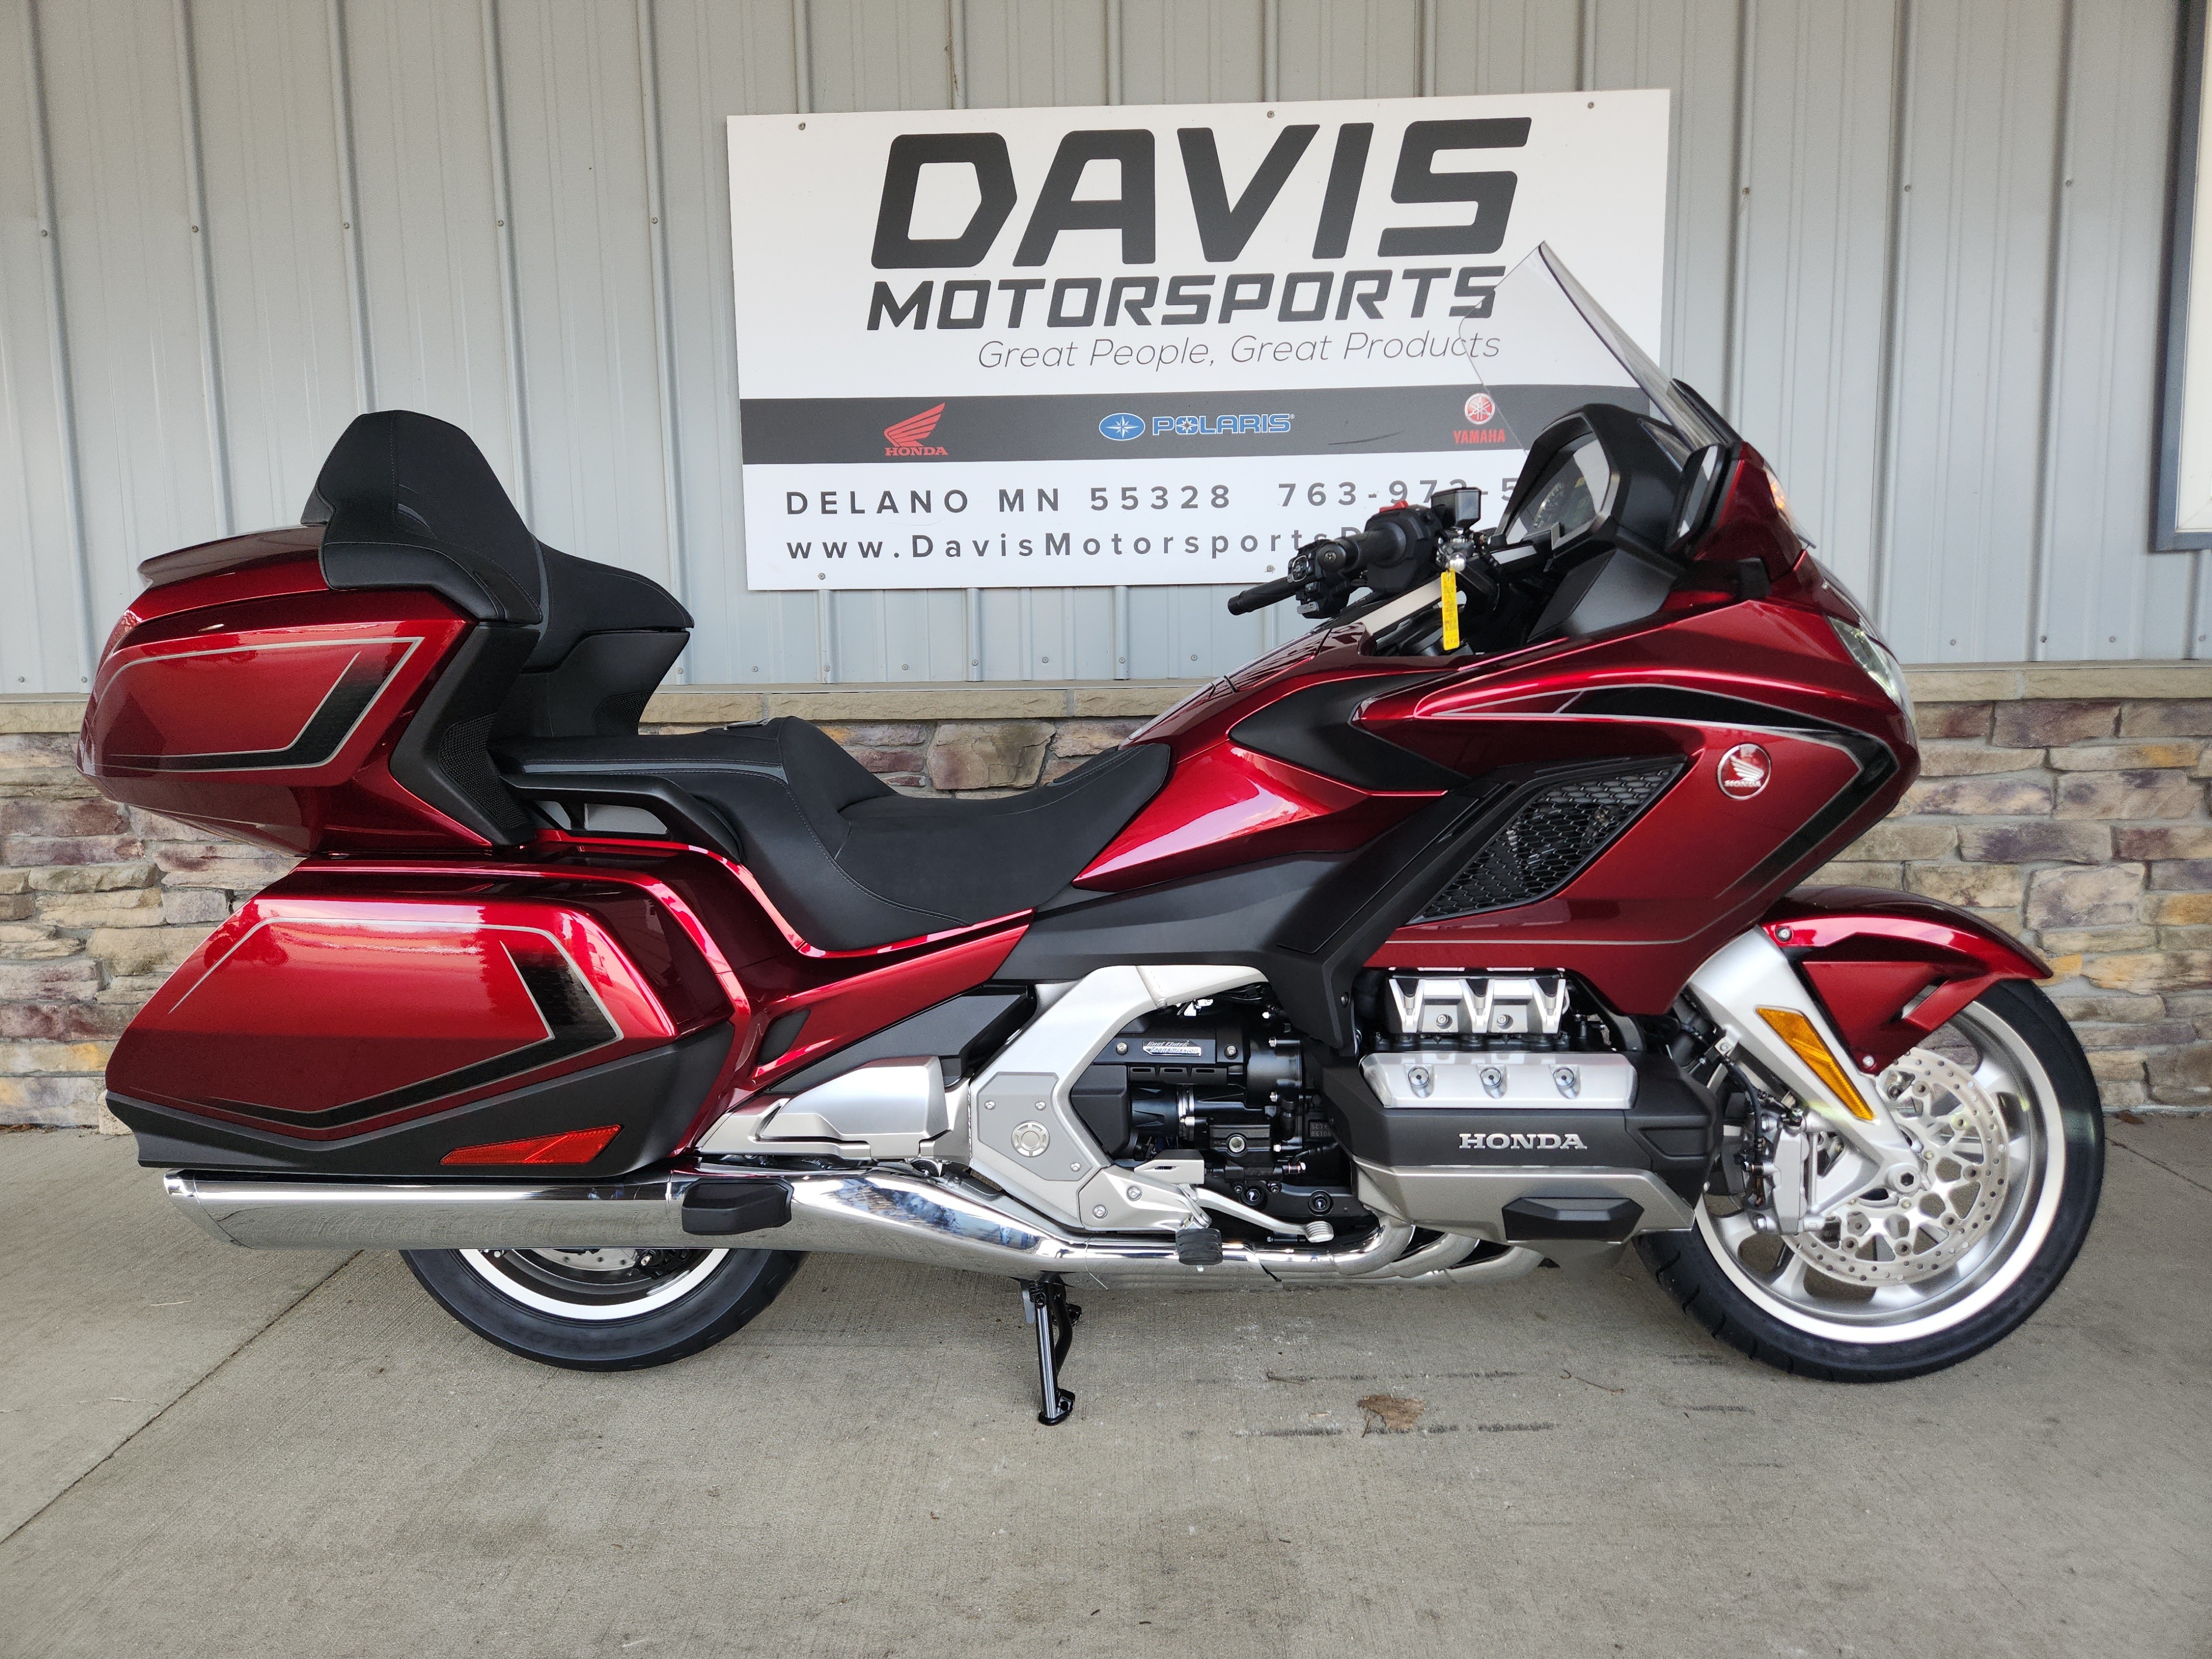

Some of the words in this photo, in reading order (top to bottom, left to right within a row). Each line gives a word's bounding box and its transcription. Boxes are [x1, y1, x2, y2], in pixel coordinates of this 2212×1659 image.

[872, 117, 1532, 269] DAVIS
[867, 266, 1506, 331] MOTORSPORTS
[979, 341, 1078, 368] Great
[1089, 337, 1214, 372] People,
[1231, 335, 1332, 363] Great
[1343, 330, 1500, 360] Products
[1152, 414, 1291, 436] POLARIS
[1453, 429, 1506, 445] YAMAHA
[885, 446, 948, 456] HONDA
[786, 489, 968, 515] DELANO
[999, 488, 1058, 512] MN
[1091, 485, 1229, 511] 55328
[1459, 1133, 1588, 1149] HONDA
